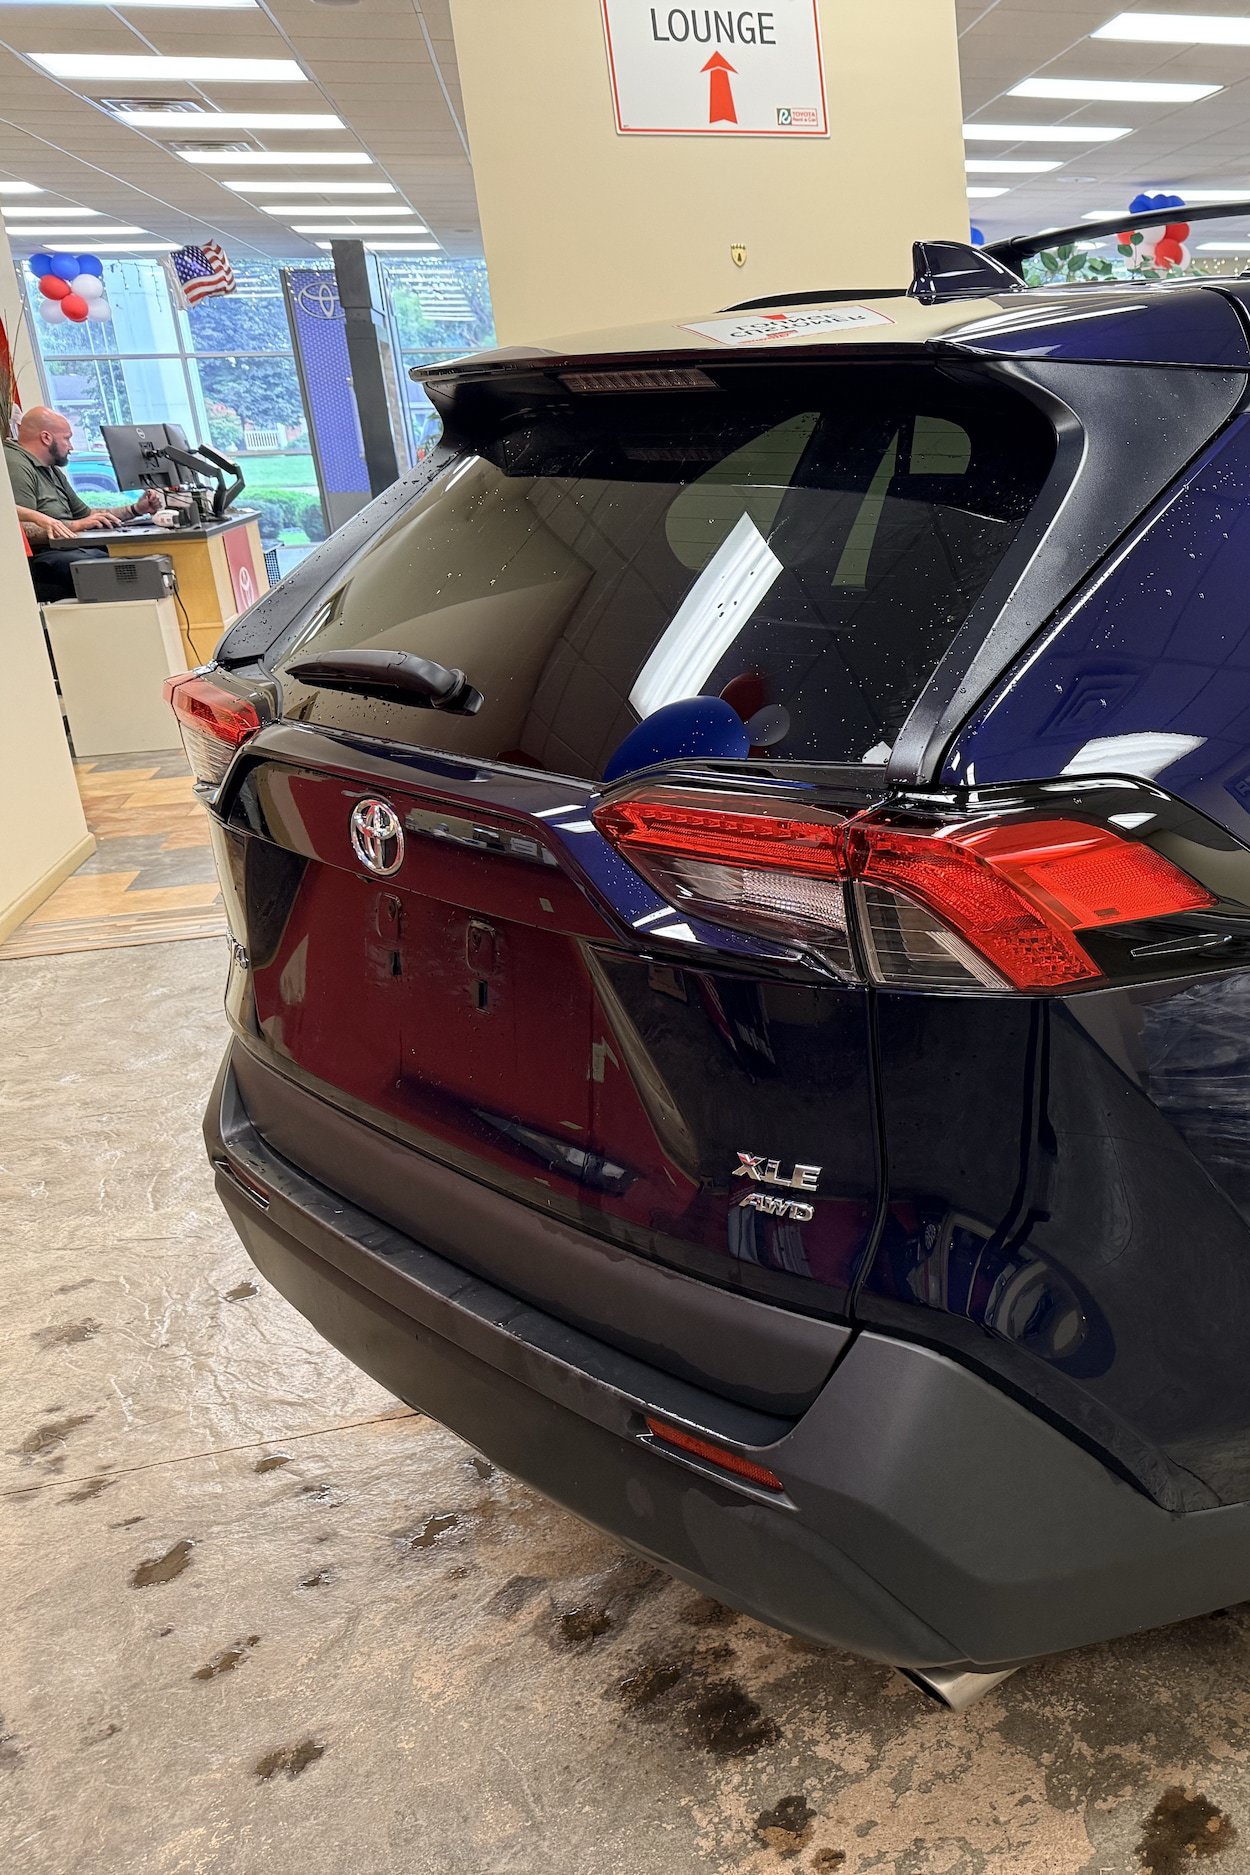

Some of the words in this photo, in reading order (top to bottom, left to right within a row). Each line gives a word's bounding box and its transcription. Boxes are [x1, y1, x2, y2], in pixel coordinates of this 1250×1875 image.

[650, 8, 777, 45] LOUNGE
[731, 1150, 823, 1192] XLE
[739, 1192, 816, 1222] AWD
